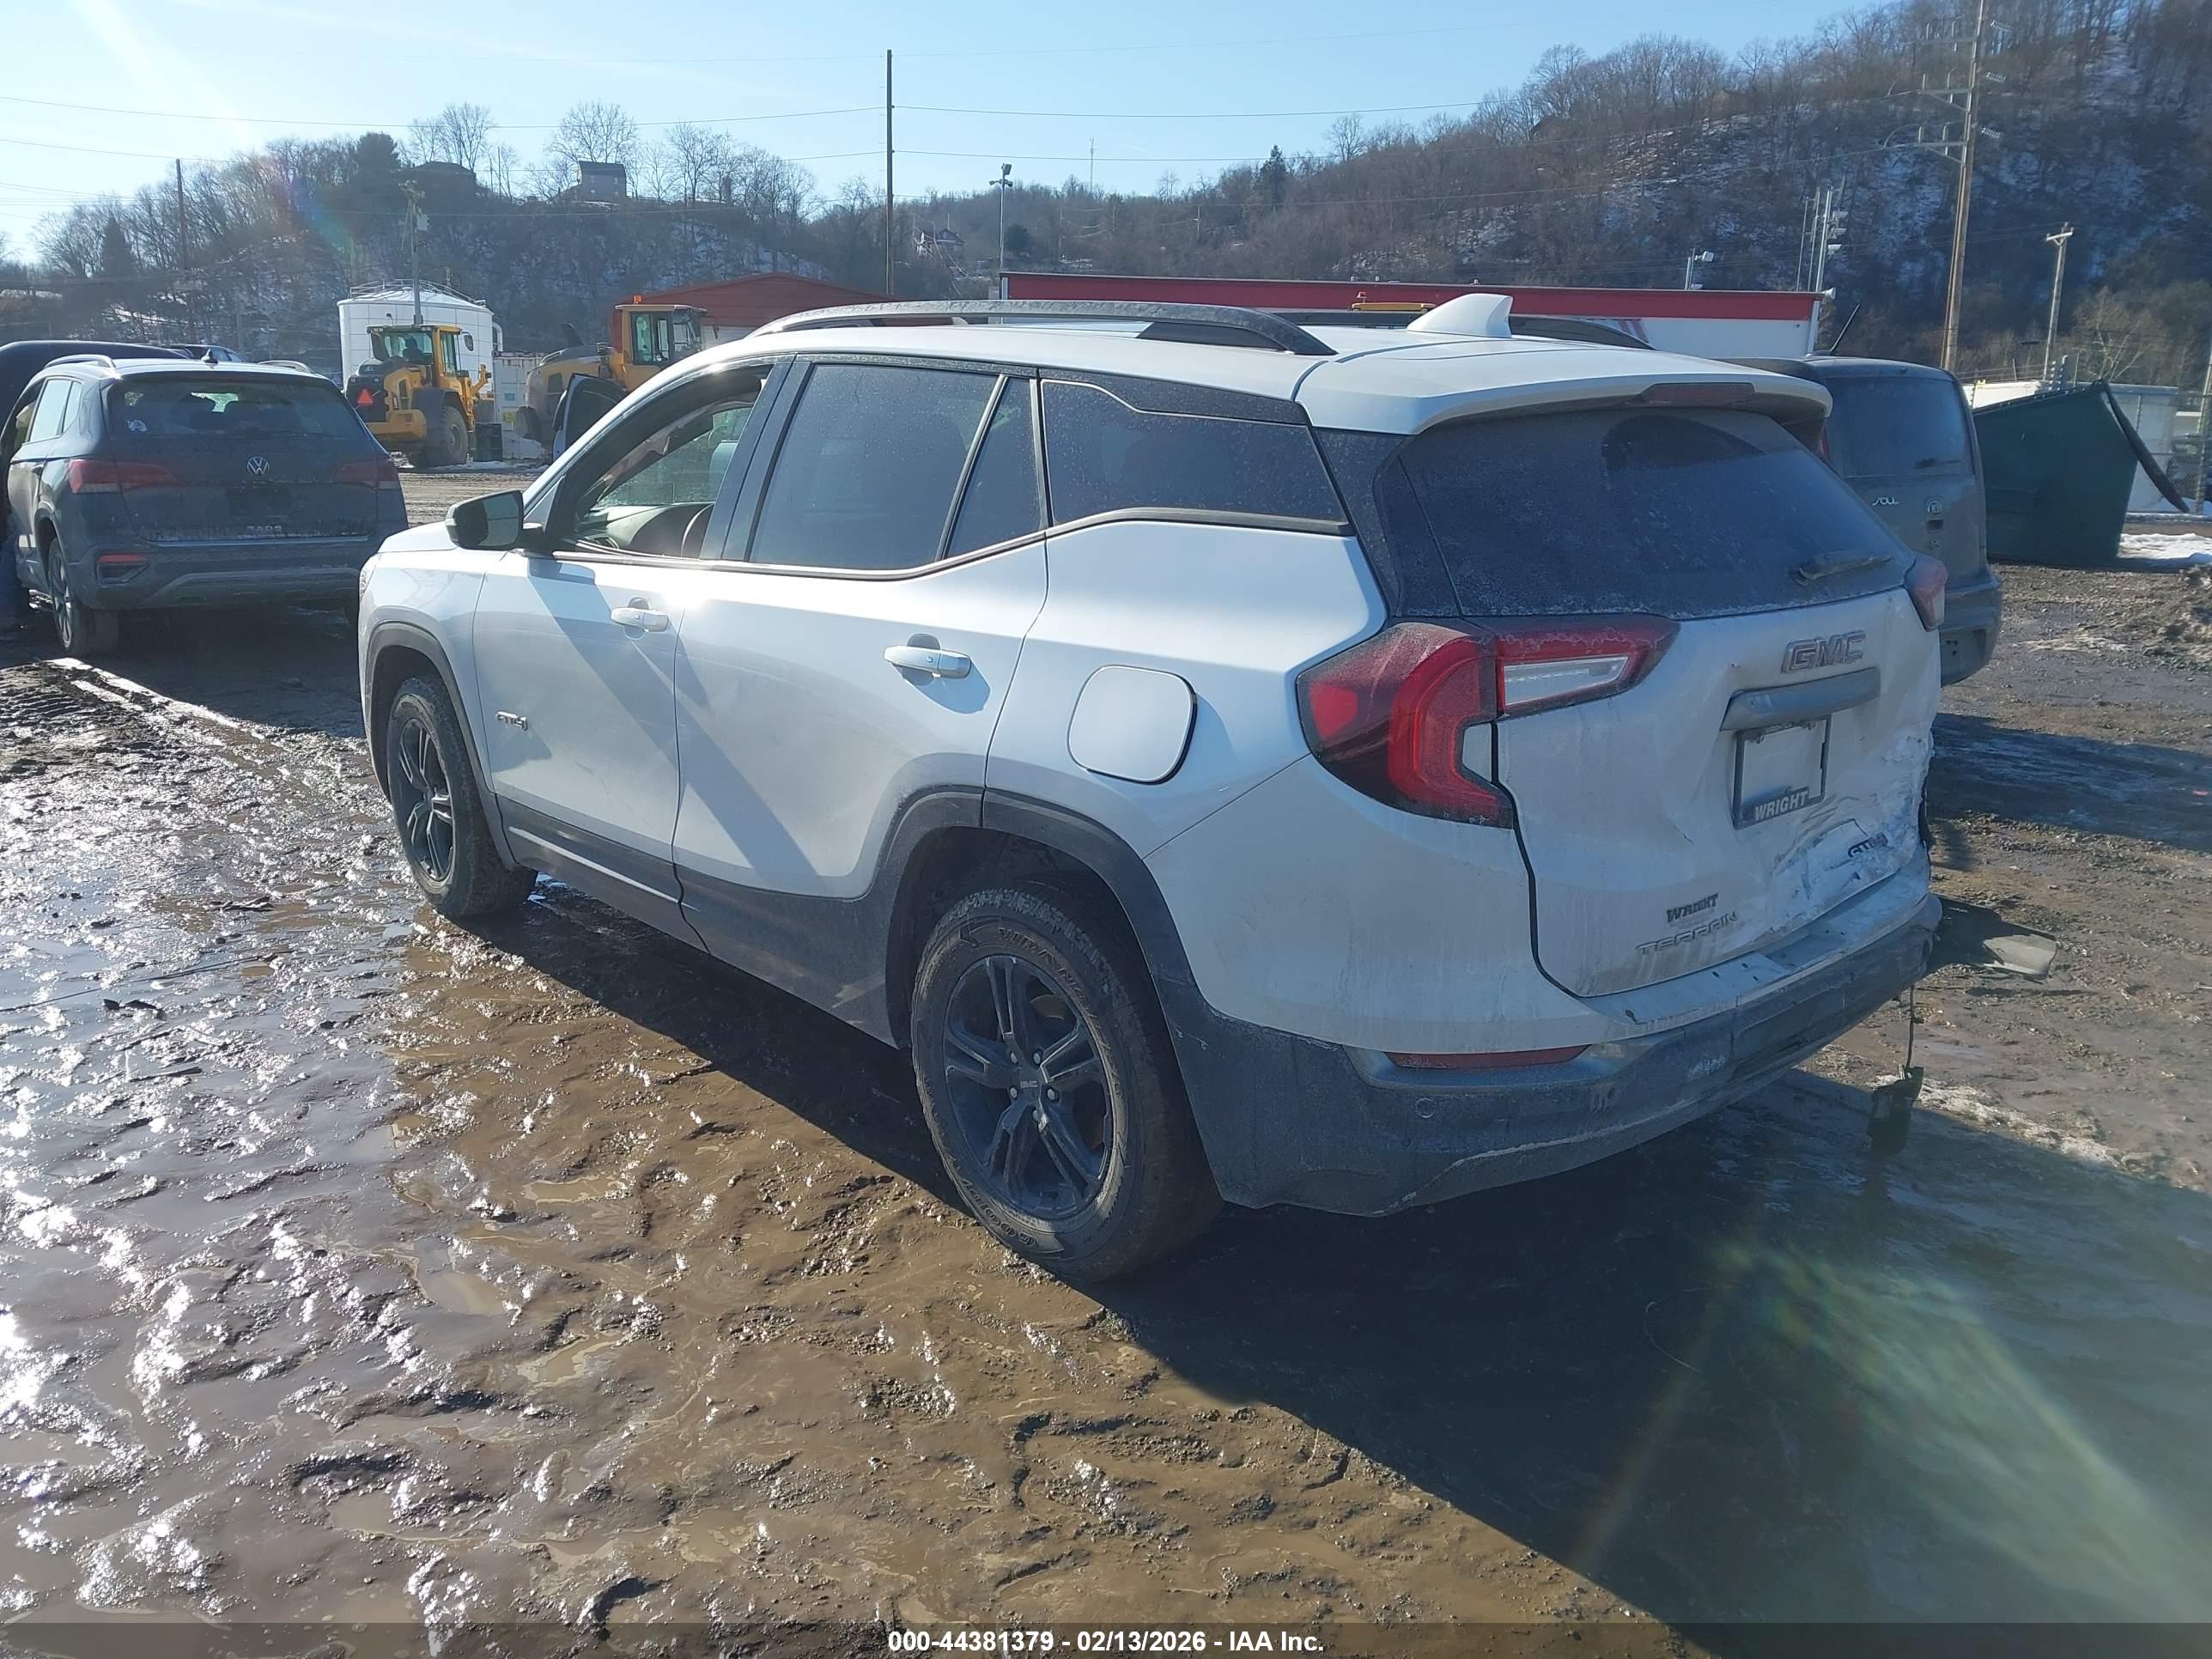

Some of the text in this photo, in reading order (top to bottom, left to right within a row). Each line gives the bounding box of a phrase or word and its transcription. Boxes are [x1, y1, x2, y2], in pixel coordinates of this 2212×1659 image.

[1780, 629, 1867, 674] GMC
[1754, 789, 1809, 821] WRIGHT
[1666, 892, 1720, 924] WRIGHT
[1634, 908, 1739, 956] TERRAIN
